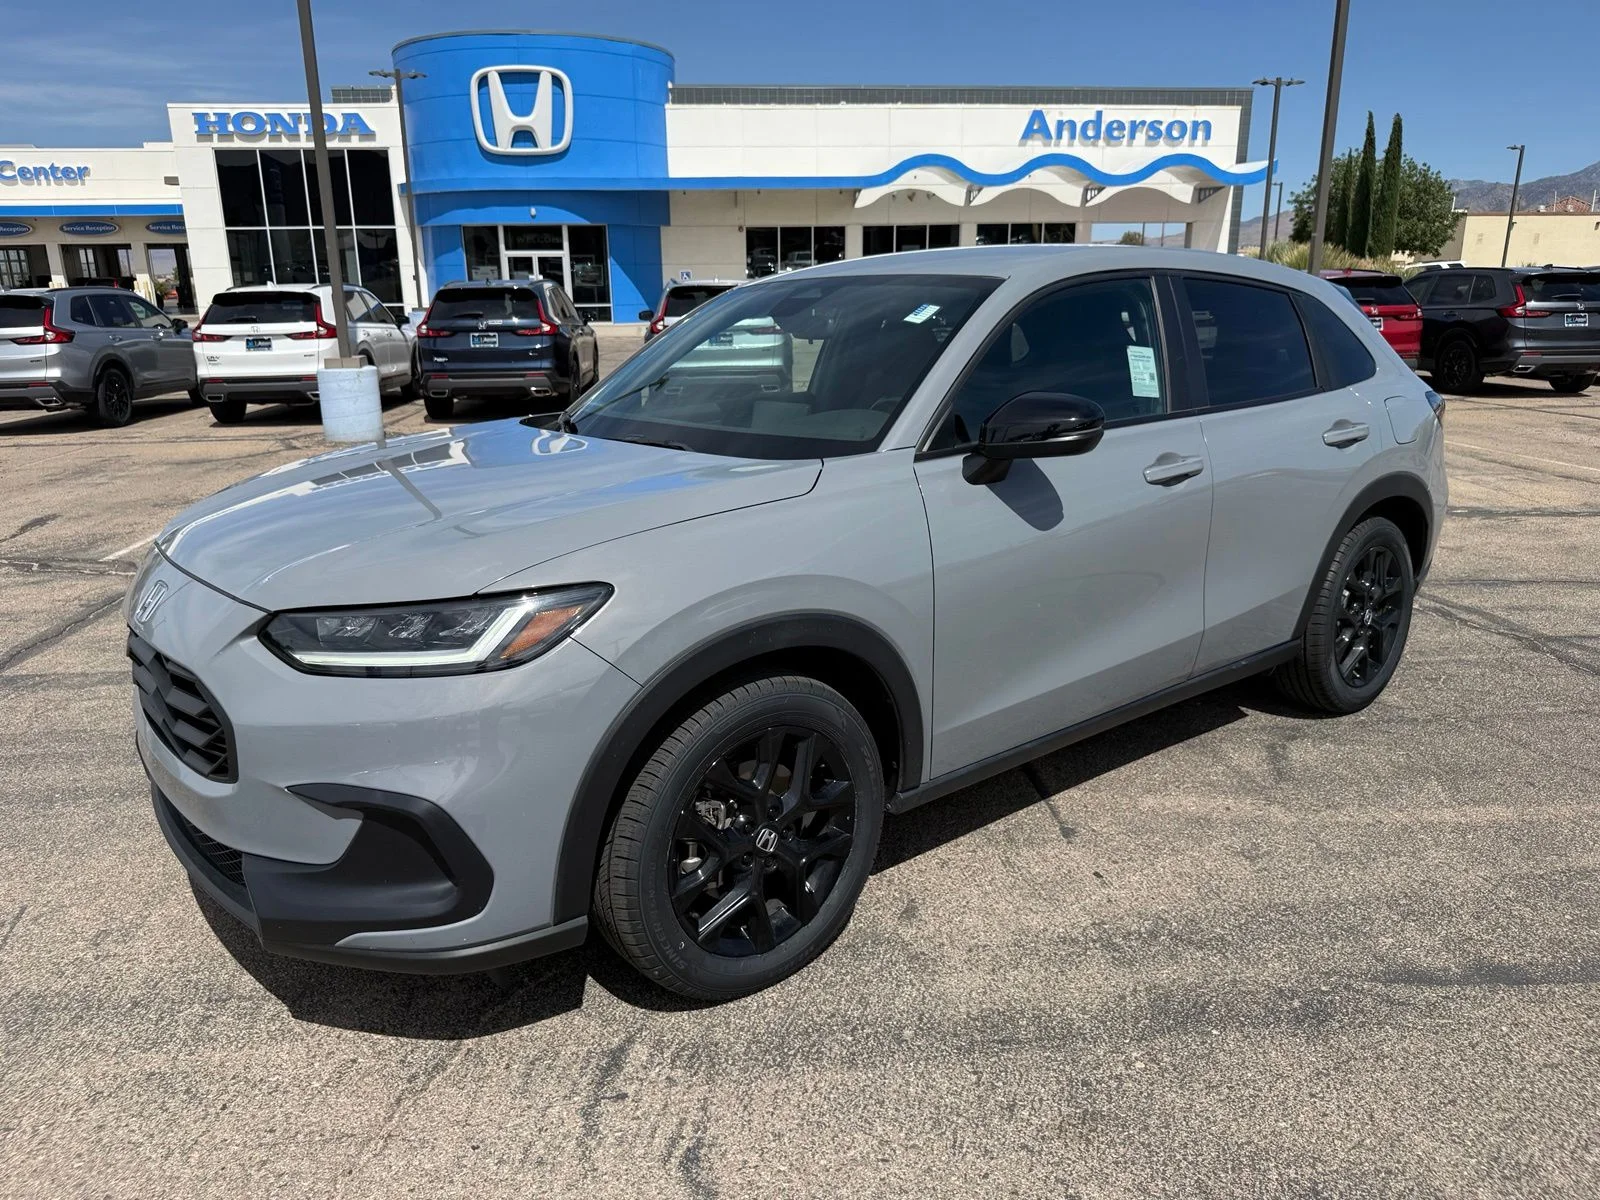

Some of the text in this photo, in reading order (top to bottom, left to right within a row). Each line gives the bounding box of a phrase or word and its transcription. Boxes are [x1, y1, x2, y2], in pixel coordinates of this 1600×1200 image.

[192, 111, 375, 136] HONDA
[1020, 109, 1213, 142] Anderson
[0, 159, 89, 181] Center
